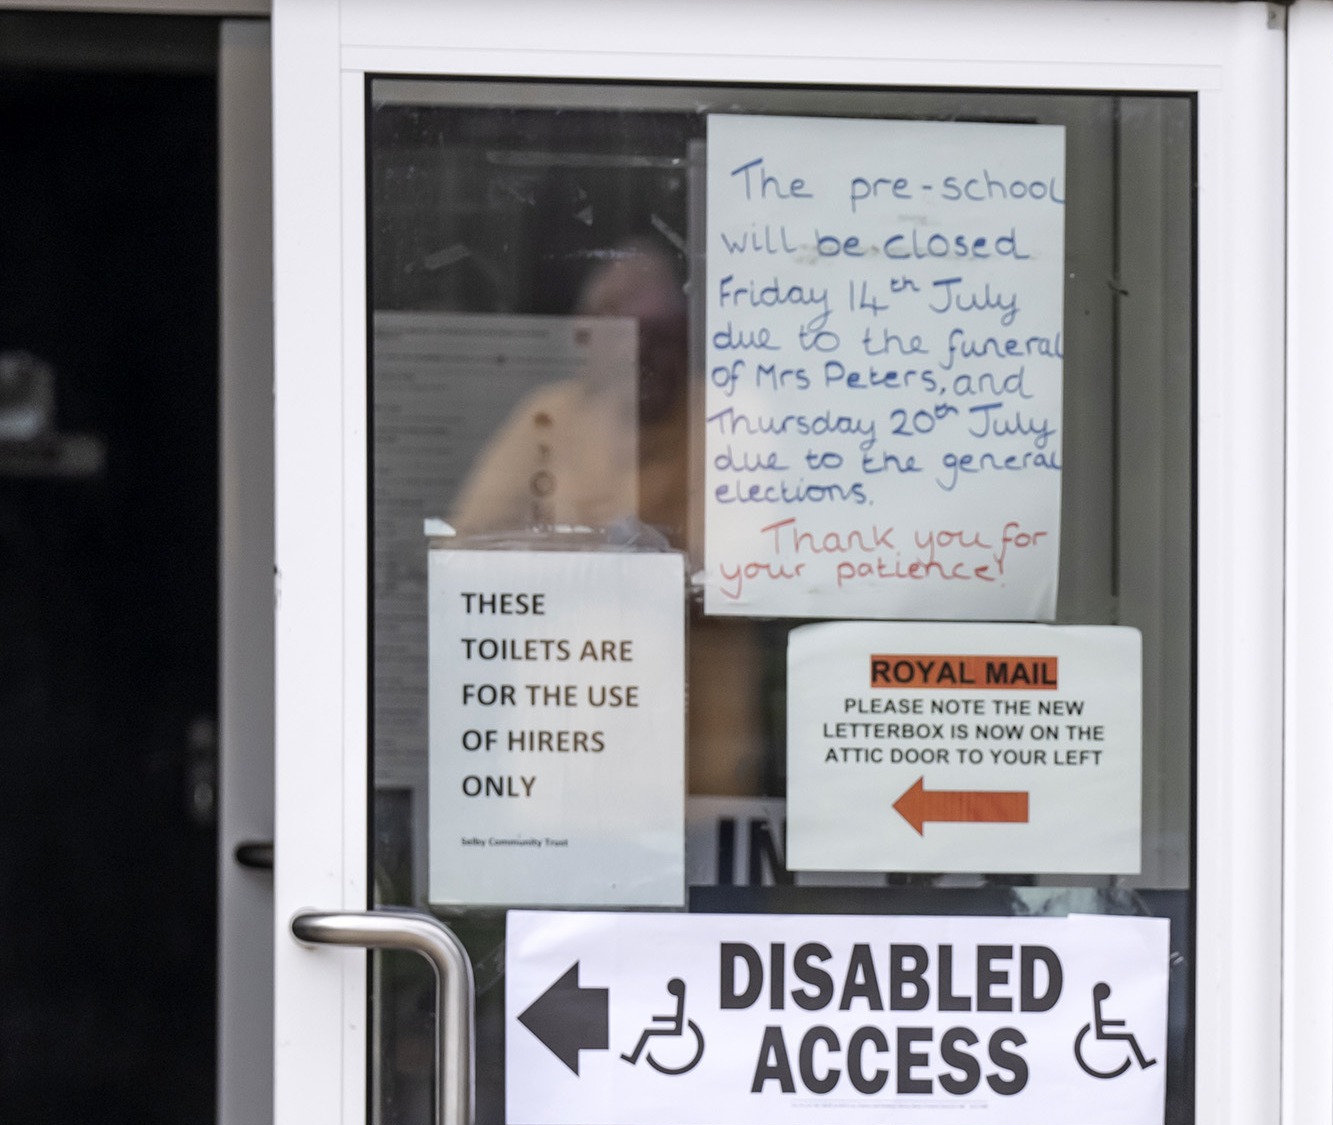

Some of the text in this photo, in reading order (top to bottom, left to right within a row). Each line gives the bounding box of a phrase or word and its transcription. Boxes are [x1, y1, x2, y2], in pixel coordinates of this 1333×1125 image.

[731, 158, 1064, 212] The pre-school
[721, 224, 1030, 260] will be closed
[719, 275, 1021, 333] Friday 14th July
[712, 321, 1064, 370] due to the funeral
[711, 360, 1034, 399] of Mrs Peters, and
[706, 402, 1056, 450] Thursday 20th July
[713, 446, 1063, 492] due to the general
[714, 477, 875, 506] elections.
[760, 517, 1049, 566] Thank you for
[719, 550, 1006, 600] your patience!
[461, 592, 546, 616] THESE
[461, 637, 634, 662] TOILETS ARE
[871, 660, 1058, 685] ROYAL MAIL
[462, 684, 640, 707] FOR THE USE
[844, 697, 1085, 717] PLEASE NOTE THE NEW
[462, 730, 606, 753] OF HIRERS
[823, 722, 1105, 742] LETTERBOX IS NOW ON THE
[824, 747, 1104, 766] ATTIC DOOR TO YOUR LEFT
[462, 775, 537, 798] ONLY
[719, 941, 1064, 1013] DISABLED
[750, 1025, 1030, 1097] ACCESS
